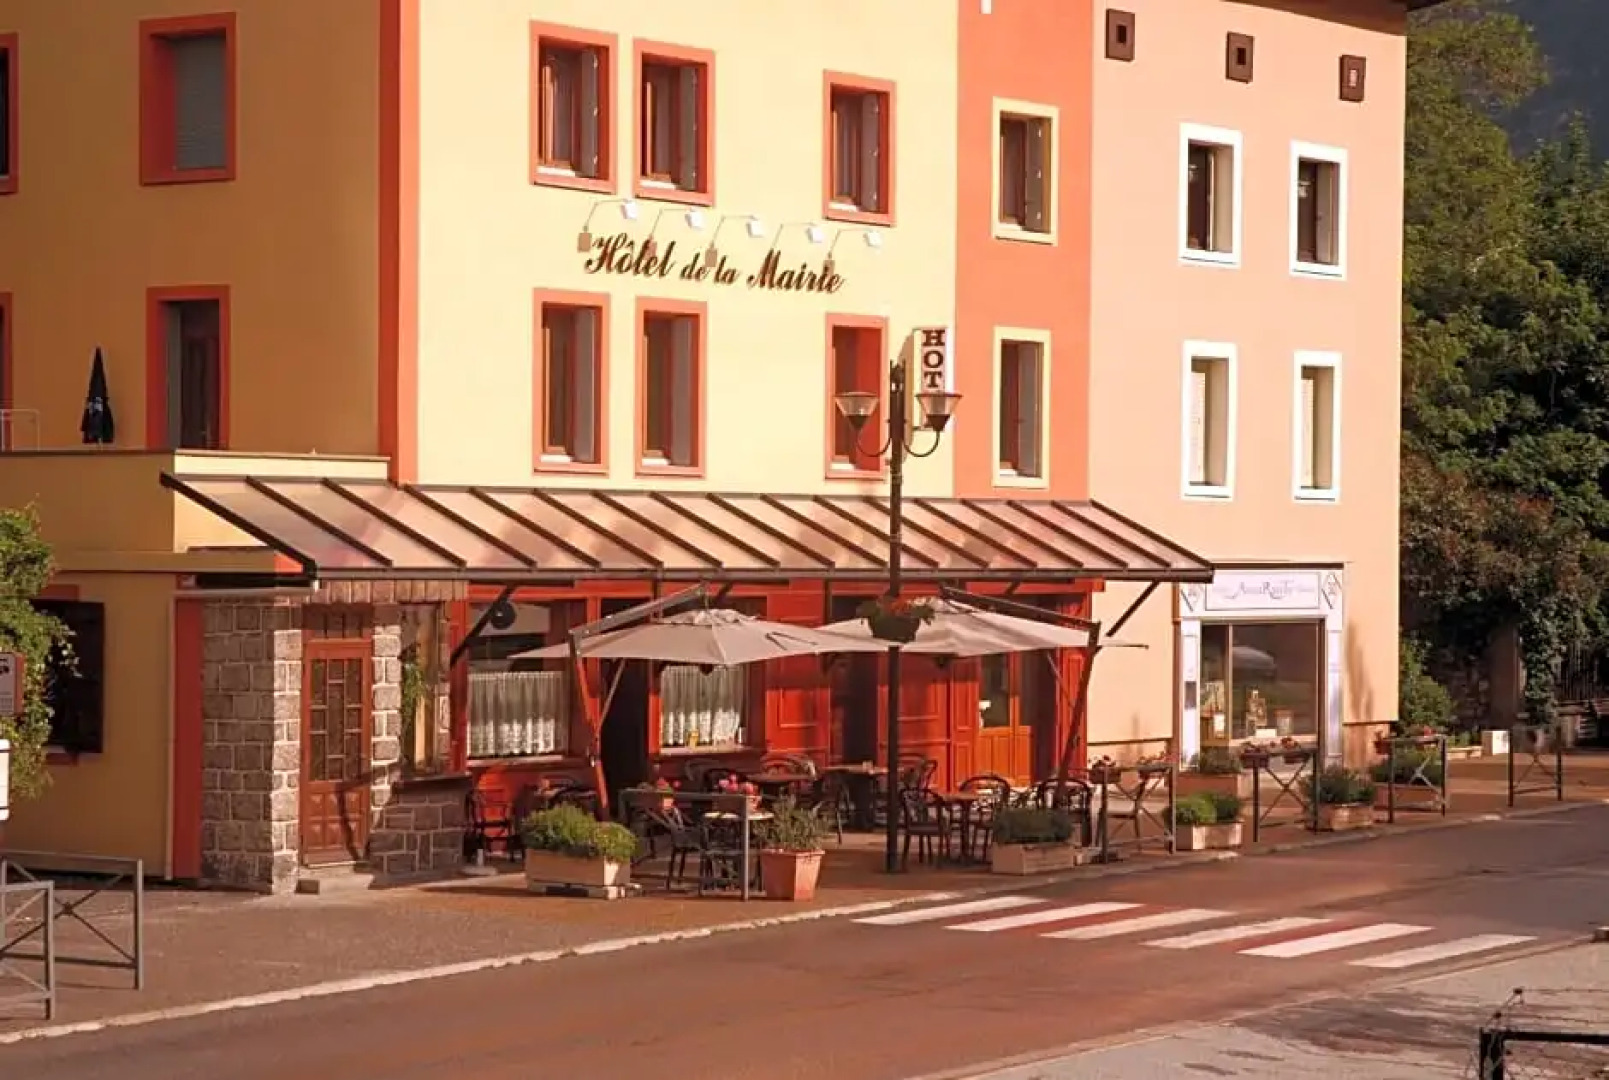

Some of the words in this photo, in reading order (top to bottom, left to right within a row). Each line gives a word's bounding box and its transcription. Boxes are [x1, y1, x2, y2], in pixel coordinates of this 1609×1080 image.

[584, 232, 676, 277] Hôtel
[679, 252, 708, 281] de
[713, 255, 739, 284] la
[747, 249, 845, 294] Mairie
[922, 329, 946, 390] HOT
